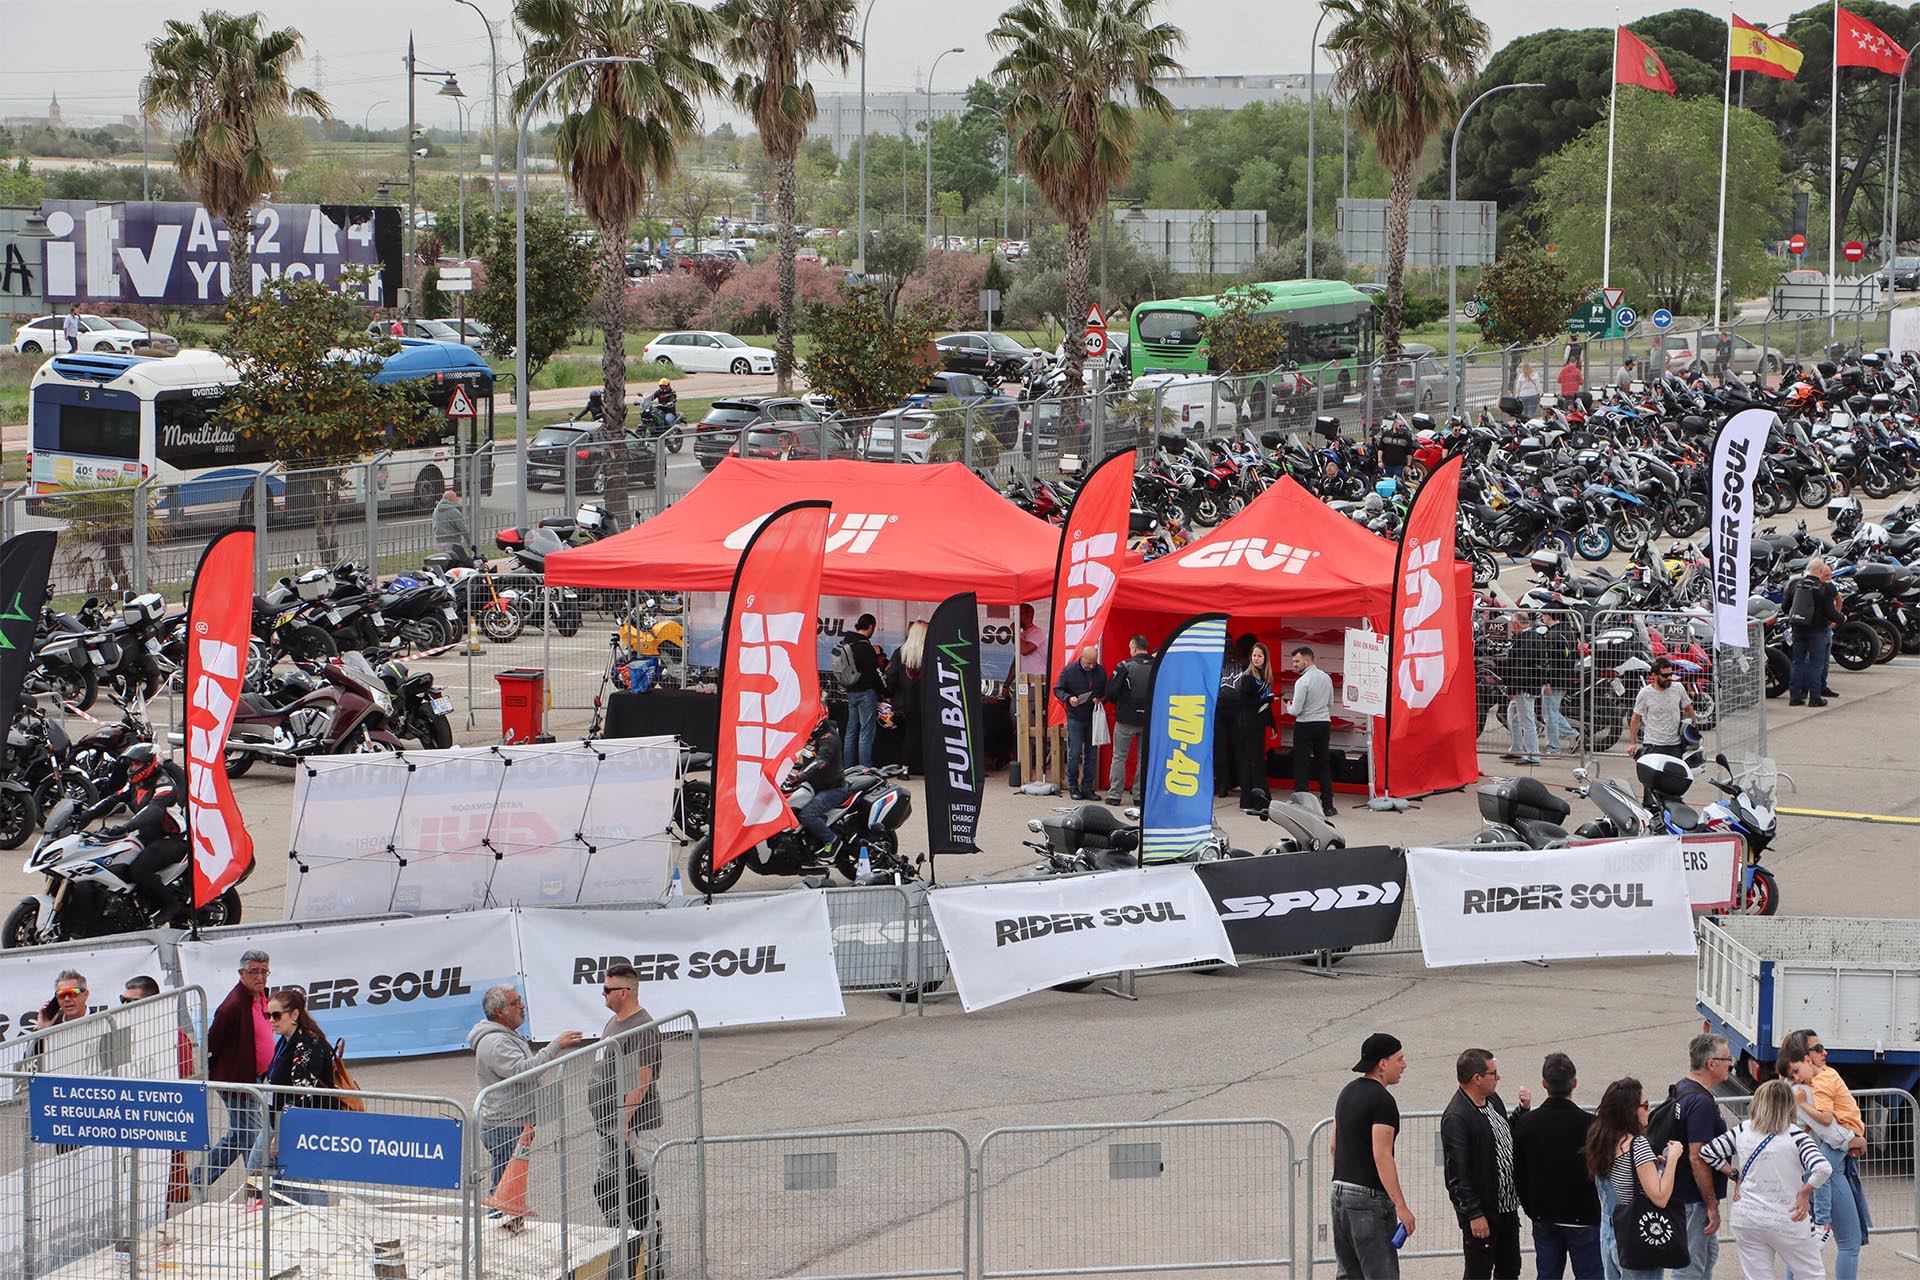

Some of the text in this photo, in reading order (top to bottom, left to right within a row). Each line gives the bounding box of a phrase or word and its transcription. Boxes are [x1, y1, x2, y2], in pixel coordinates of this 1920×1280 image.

[1086, 338, 1102, 348] 40
[84, 391, 91, 401] 3
[1718, 437, 1750, 606] RIDER SOUL
[1178, 537, 1313, 575] GIVI
[817, 617, 846, 637] OUL
[981, 625, 1016, 645] SO
[1398, 538, 1441, 709] GIVI
[1488, 623, 1505, 631] AMS
[1668, 625, 1684, 635] AMS
[936, 661, 973, 793] FULBAT
[1165, 695, 1206, 797] WD-40
[189, 639, 239, 885] GIVI
[952, 825, 972, 833] BOOST
[1221, 881, 1402, 921] SPIDI
[1463, 882, 1653, 915] RIDER SOUL
[996, 901, 1187, 947] RIDER SOUL
[688, 945, 786, 979] SOUL
[366, 966, 471, 1005] SOUL
[53, 1086, 183, 1104] EL ACCESO AL EVENTO
[44, 1105, 194, 1124] SE REGULARÁ EN FUNCIÓN
[53, 1124, 188, 1142] DEL AFORO DISPONIBLE
[296, 1134, 444, 1160] ACCESO TAQUILLA
[1639, 1211, 1669, 1226] FOKIN
